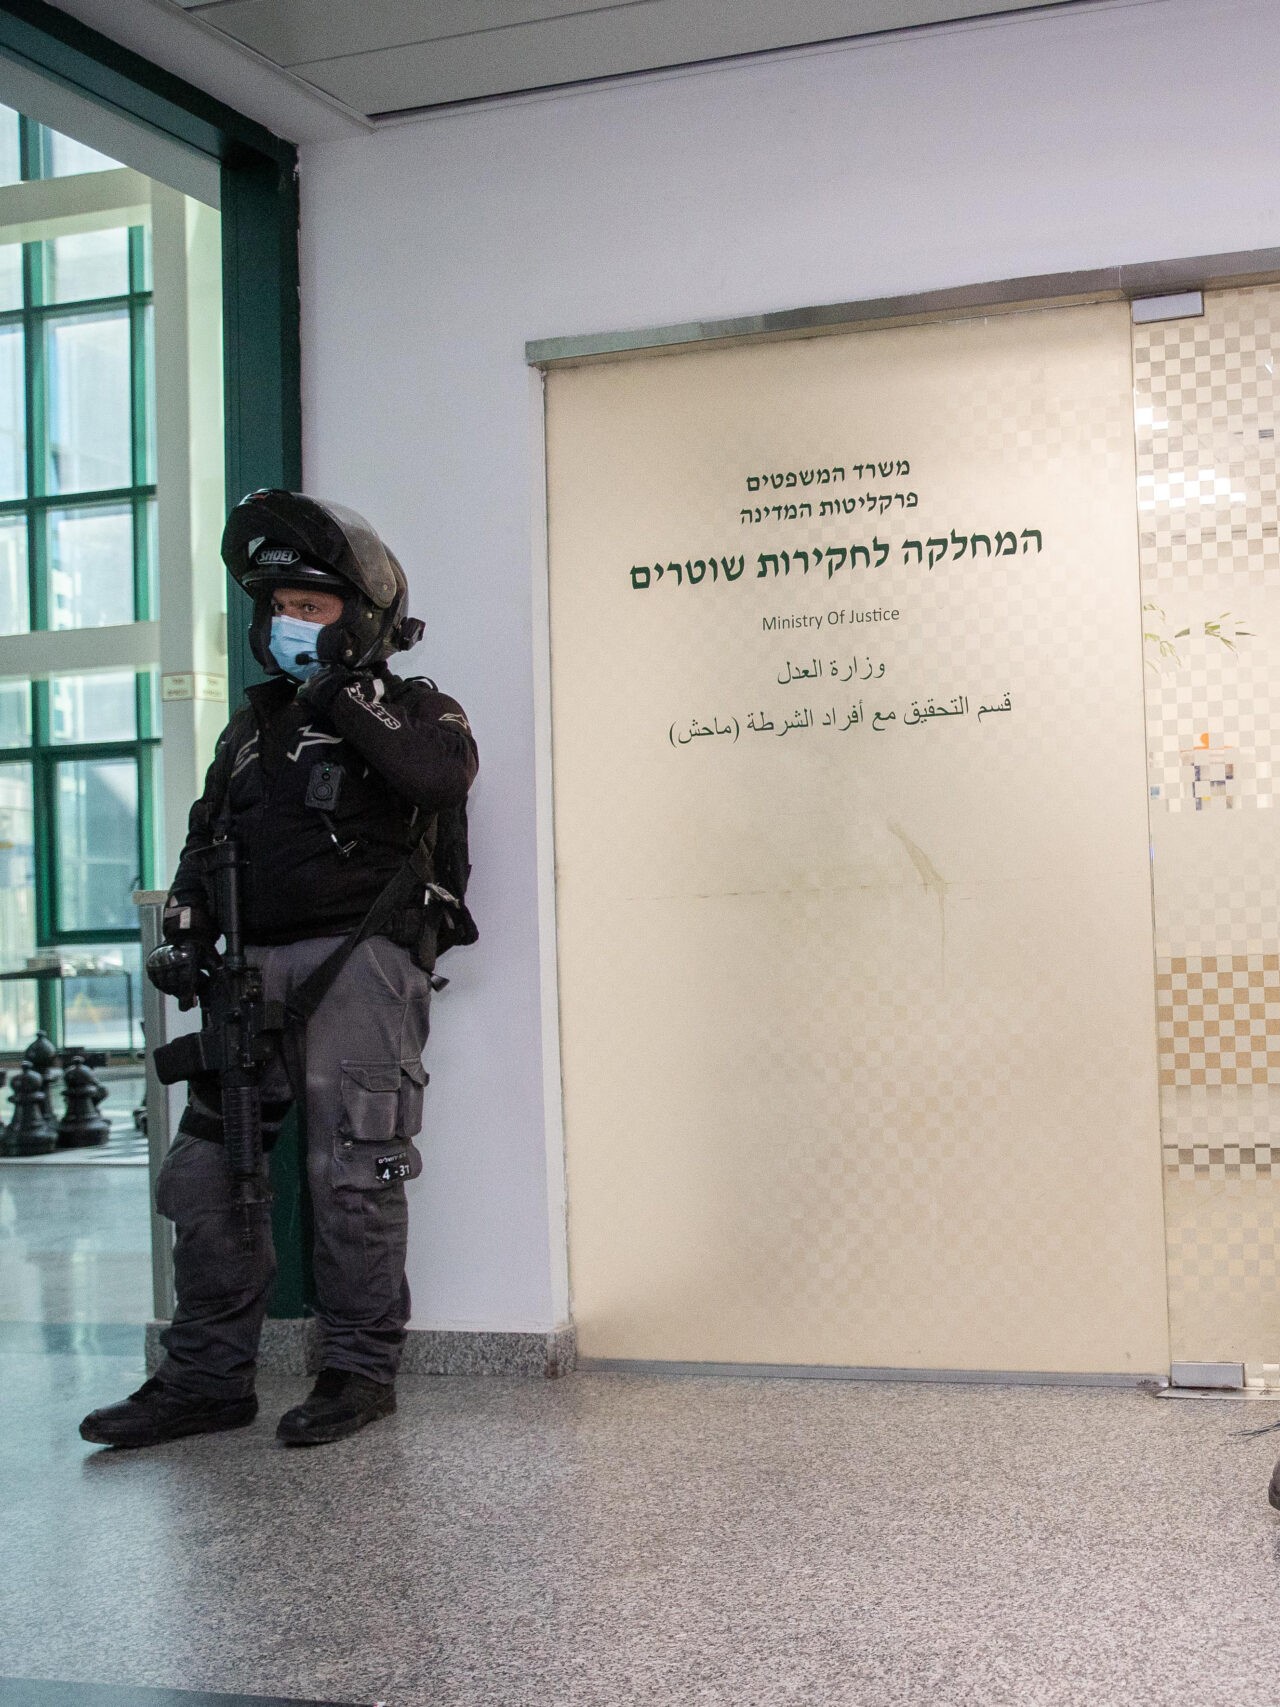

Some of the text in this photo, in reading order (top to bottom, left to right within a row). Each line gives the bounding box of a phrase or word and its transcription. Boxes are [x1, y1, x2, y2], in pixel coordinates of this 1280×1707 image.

[746, 460, 910, 492] משרד המשפטים
[740, 492, 919, 524] פרקליטות המדינה
[260, 550, 294, 562] SHOEI
[629, 528, 1043, 590] המחלקה לחקירות שוטרים
[762, 607, 900, 631] Ministry Of Justice
[777, 656, 886, 684] وزارة العدل
[669, 692, 1012, 748] قسم التحقيق مع أفراد الشرطة (ماحش)
